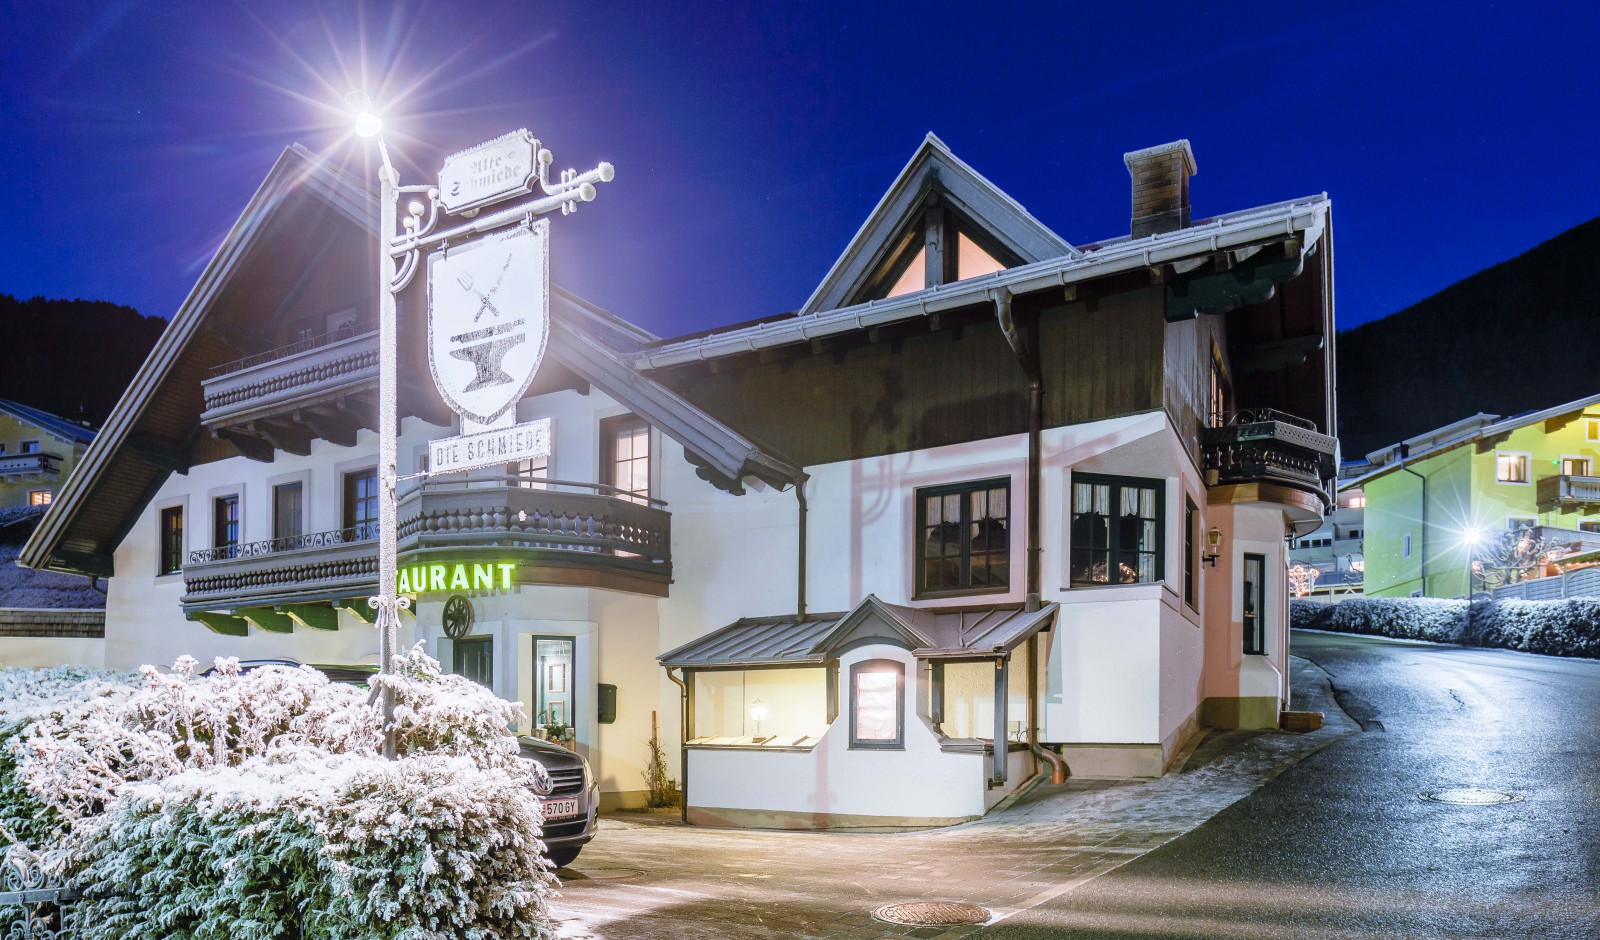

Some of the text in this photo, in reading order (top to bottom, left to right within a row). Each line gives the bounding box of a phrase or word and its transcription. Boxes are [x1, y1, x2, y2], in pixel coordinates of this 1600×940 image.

[436, 428, 544, 467] DIE SCHMIEDE
[396, 563, 516, 594] AURANT
